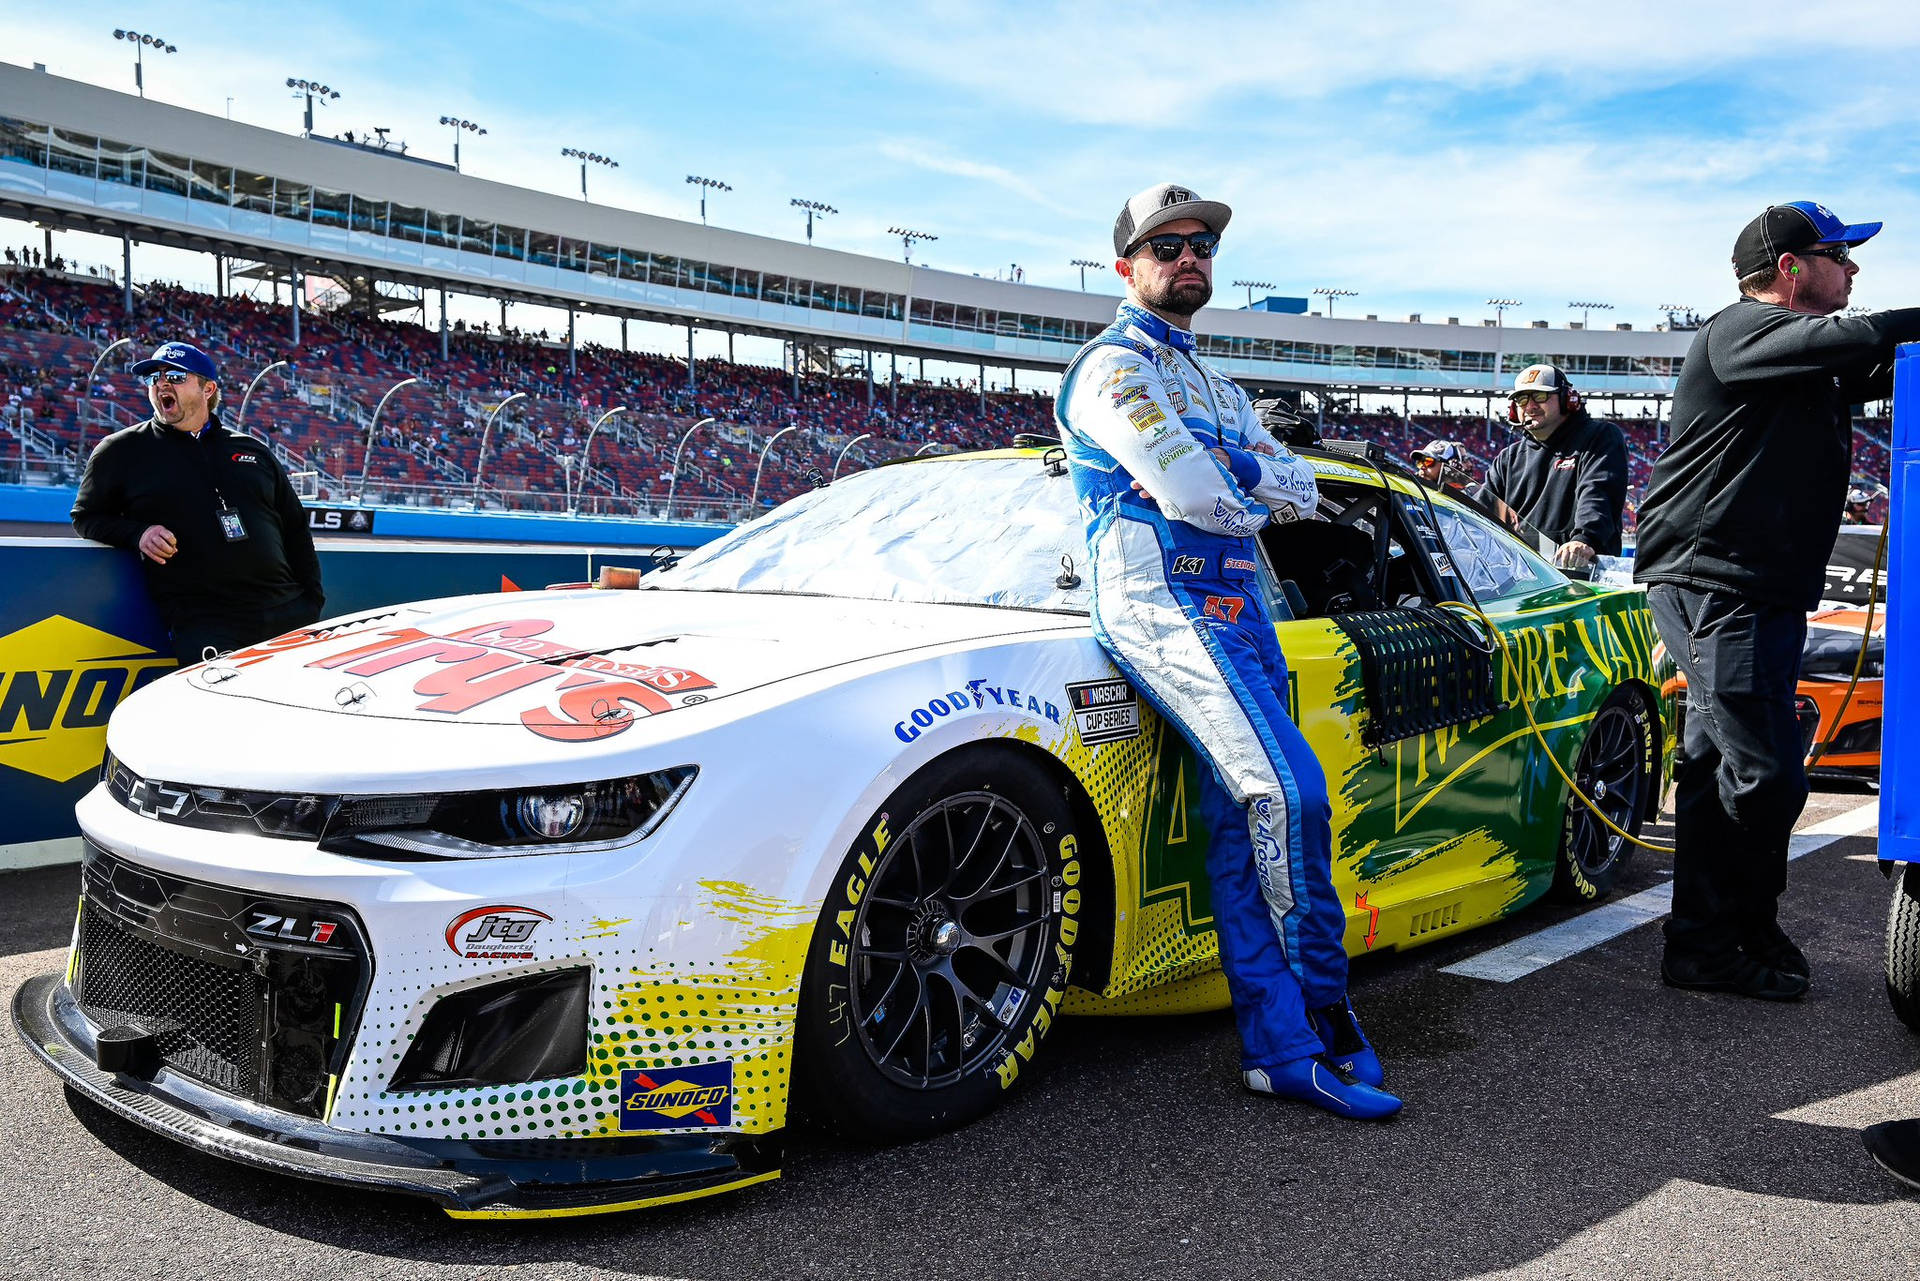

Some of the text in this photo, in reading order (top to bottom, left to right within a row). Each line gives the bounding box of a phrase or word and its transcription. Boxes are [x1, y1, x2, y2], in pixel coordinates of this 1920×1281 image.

[1115, 384, 1148, 408] SUNOCO
[1288, 470, 1315, 503] Kroger
[1219, 509, 1252, 536] Kroger
[1171, 555, 1205, 575] K1
[1203, 595, 1244, 624] 47
[1092, 684, 1128, 701] NASCAR
[894, 679, 1060, 744] GOODYEAR
[1086, 709, 1131, 730] CUP SERIES
[1639, 709, 1653, 774] EAGLE
[1254, 823, 1282, 897] Kroger
[829, 818, 892, 967] EAGLE
[246, 911, 338, 943] ZL1
[466, 915, 542, 943] jtg
[465, 951, 534, 959] RACING
[466, 943, 533, 951] Daugherty
[996, 833, 1081, 1090] GOODYEAR
[630, 1087, 724, 1108] SUNOCO
